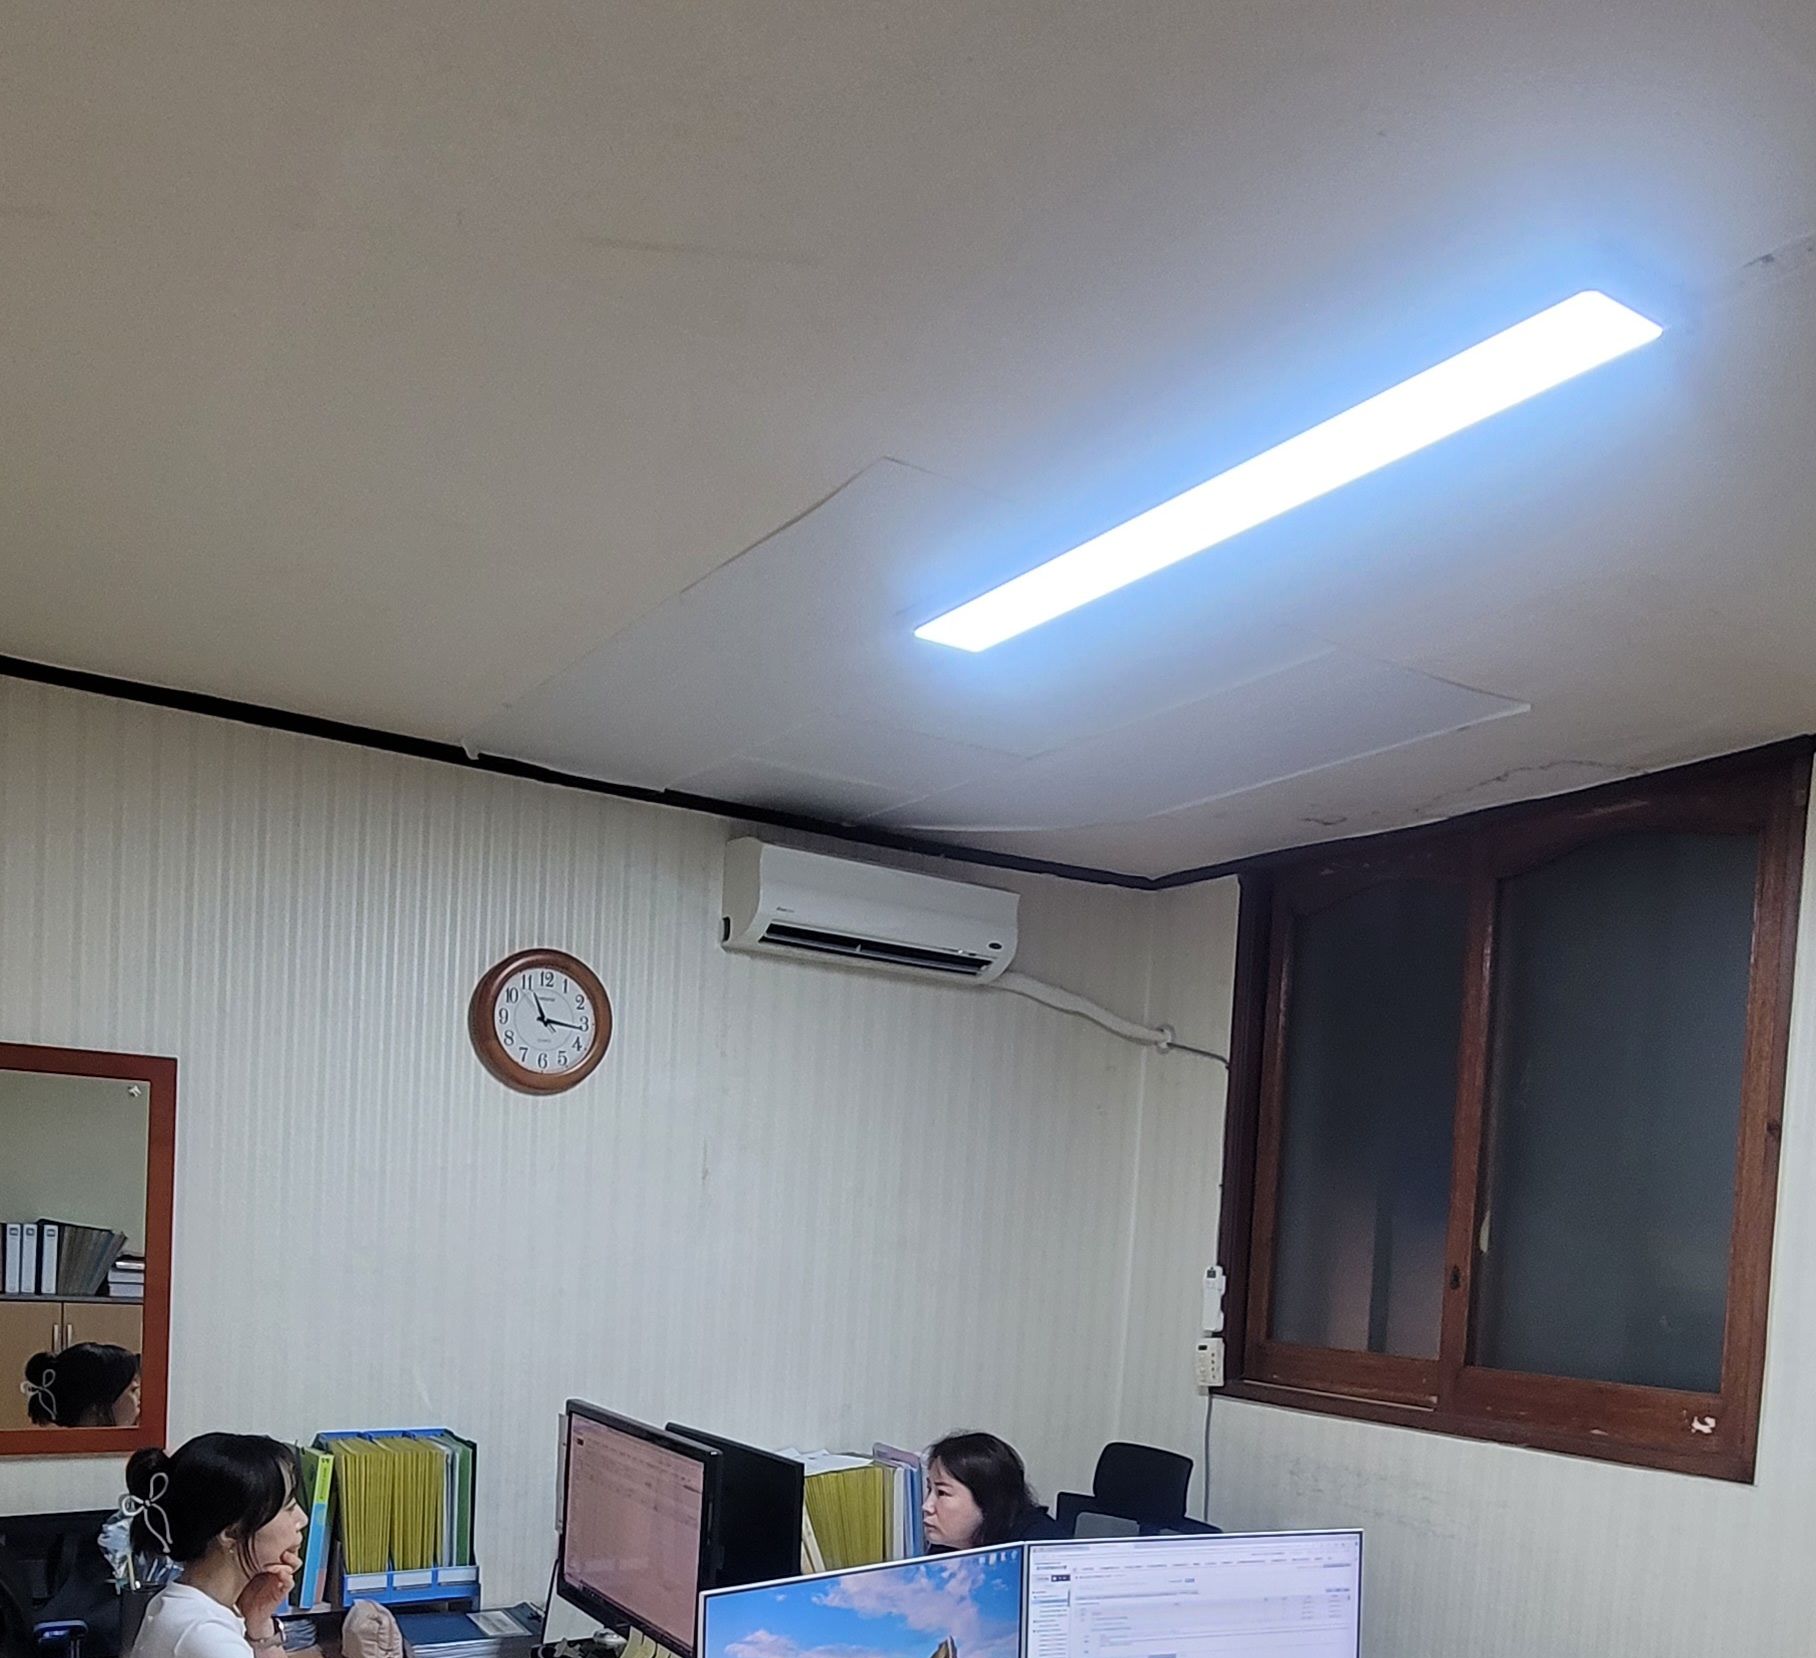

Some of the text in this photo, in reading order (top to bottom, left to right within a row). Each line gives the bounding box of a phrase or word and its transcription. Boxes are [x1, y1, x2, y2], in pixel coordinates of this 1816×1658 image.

[522, 974, 532, 991] 11
[540, 971, 554, 988] 12
[563, 978, 568, 993] 1
[505, 988, 518, 1004] 10
[575, 994, 585, 1010] 2
[499, 1008, 509, 1024] 9
[579, 1016, 589, 1032] 3
[504, 1030, 514, 1046] 8
[572, 1036, 582, 1051] 4
[519, 1047, 528, 1062] 7
[538, 1052, 548, 1069] 6
[557, 1051, 568, 1066] 5
